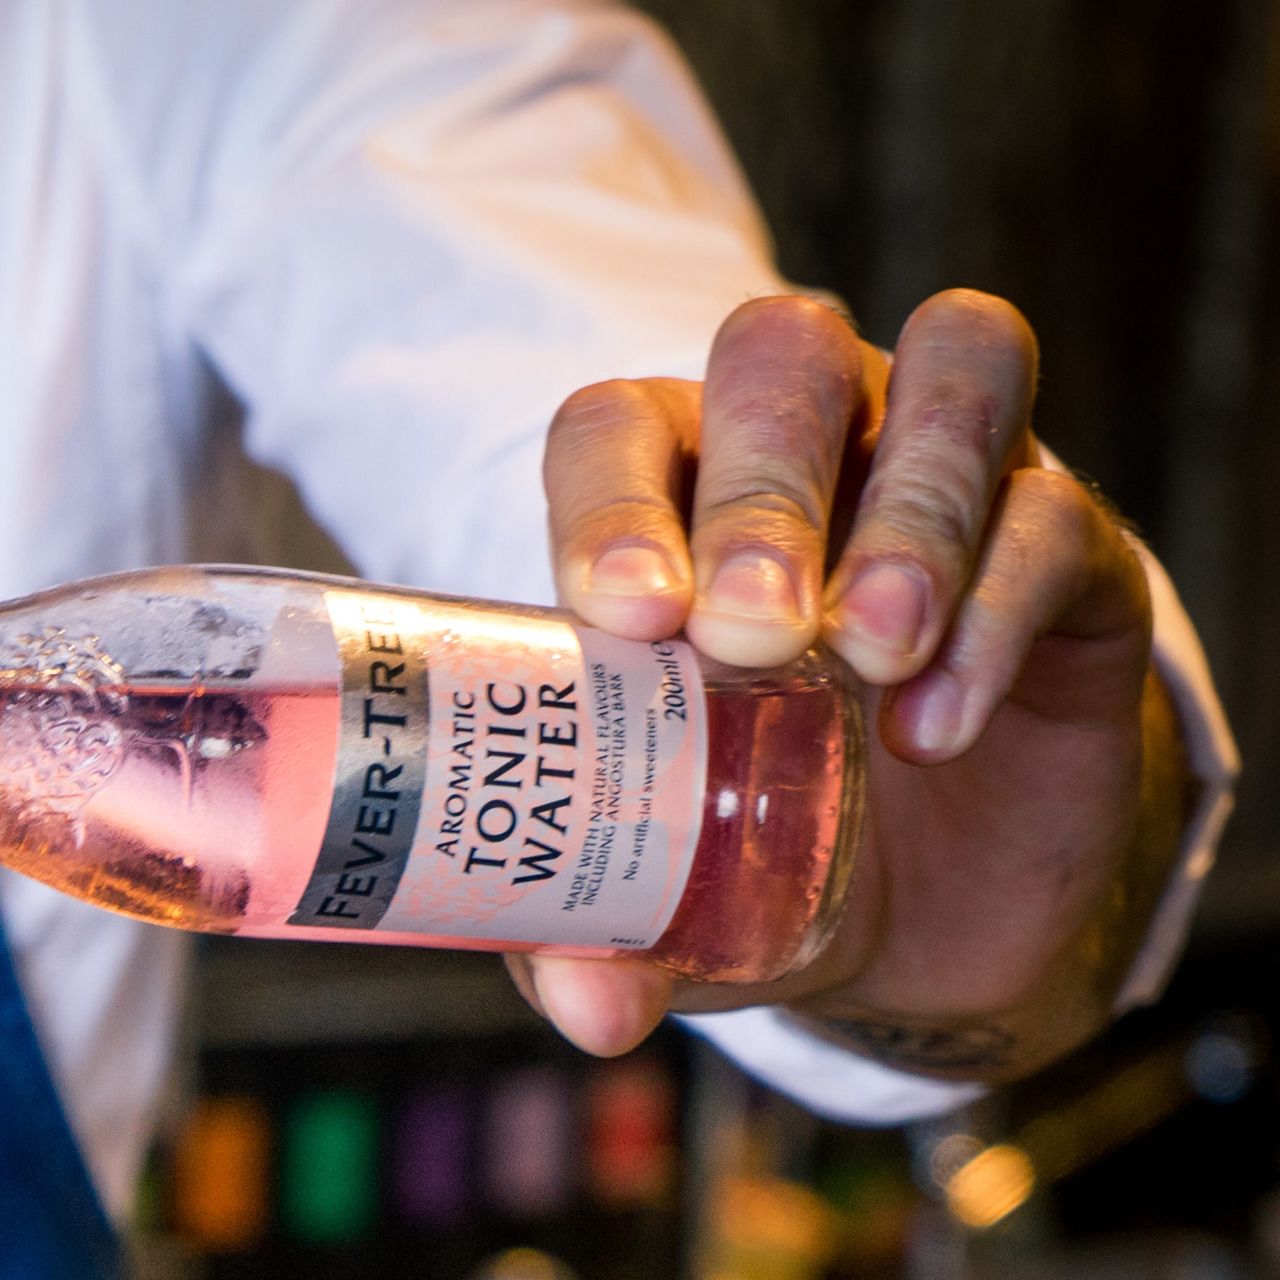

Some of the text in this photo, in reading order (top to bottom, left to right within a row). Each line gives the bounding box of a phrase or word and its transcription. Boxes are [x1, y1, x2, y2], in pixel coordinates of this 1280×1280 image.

[436, 691, 475, 857] AROMATIC
[463, 683, 527, 875] TONIC
[511, 681, 577, 886] WATER
[655, 658, 688, 722] 200ml
[561, 663, 610, 912] MADE WITH NATURAL FLAVOURS
[581, 673, 626, 906] INCLUDING ANGOSTURA BARK
[622, 708, 657, 881] No artificial sweeteners
